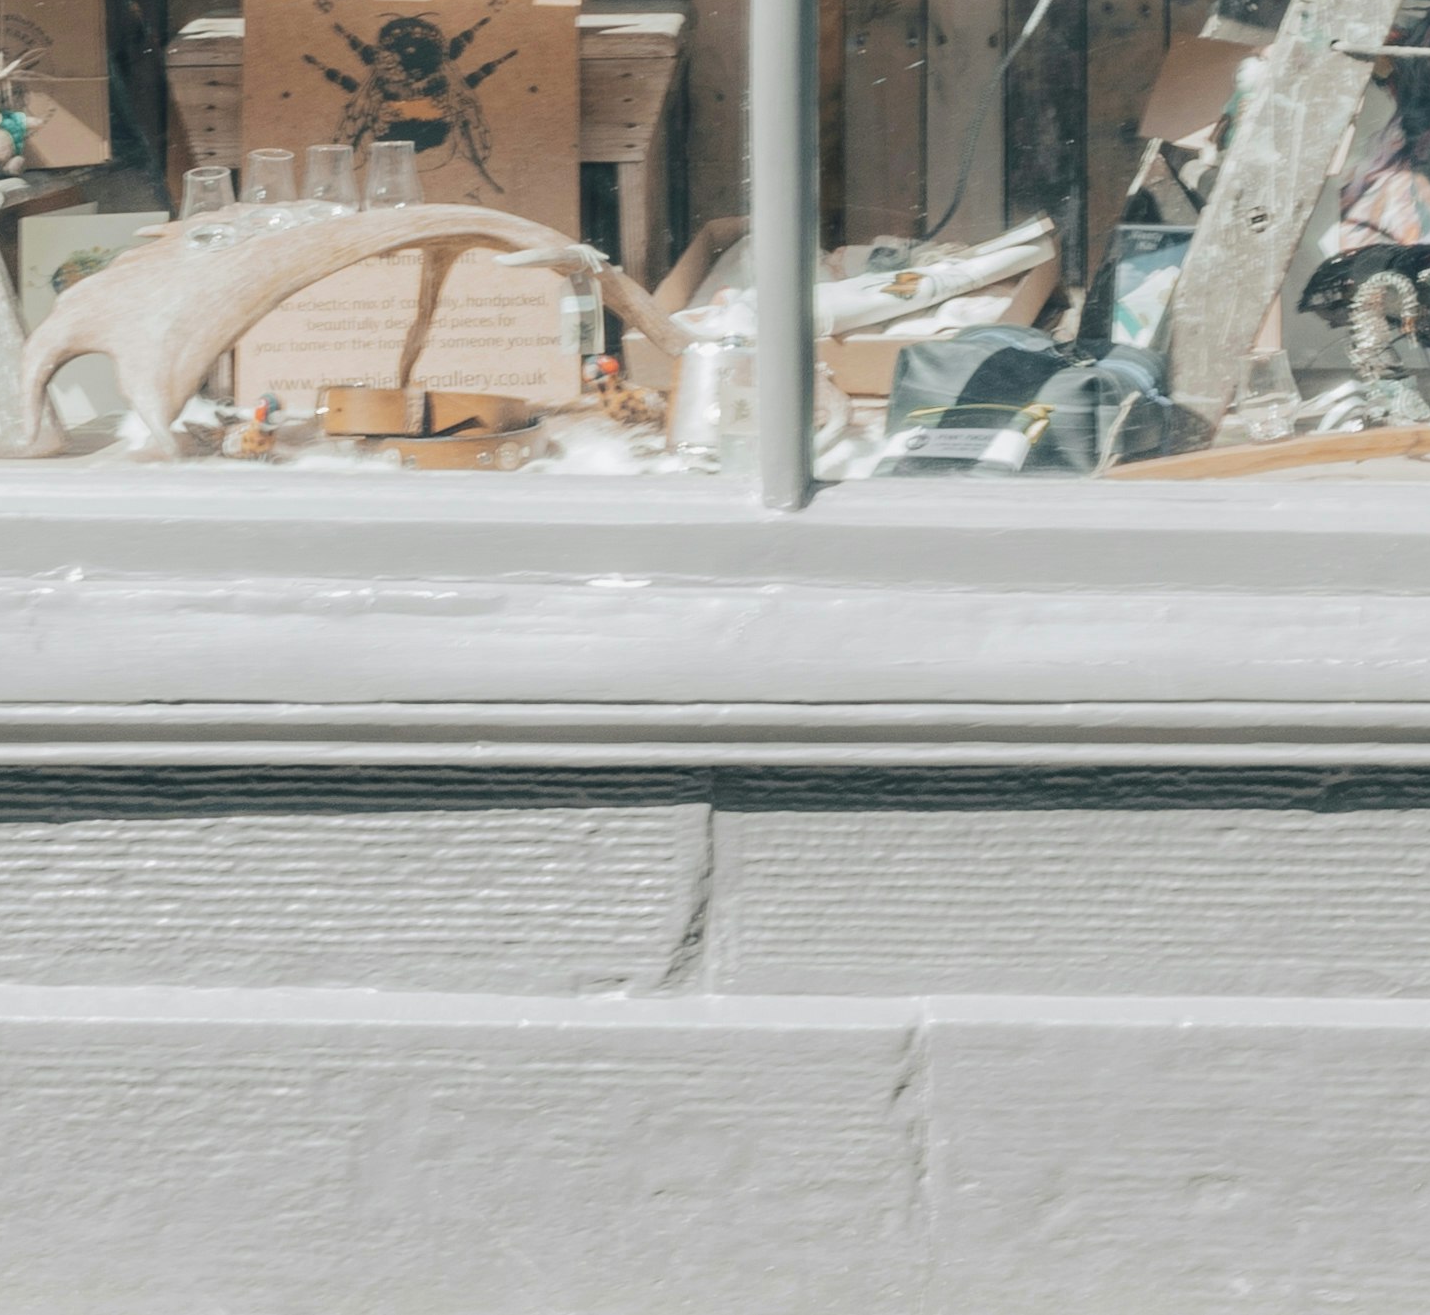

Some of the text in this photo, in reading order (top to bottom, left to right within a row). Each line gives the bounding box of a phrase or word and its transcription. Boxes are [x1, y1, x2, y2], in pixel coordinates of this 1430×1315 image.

[352, 298, 377, 310] mix
[381, 295, 397, 311] of
[385, 316, 448, 330] desed
[450, 316, 495, 331] pieces
[497, 313, 517, 328] for
[255, 342, 283, 356] your
[289, 338, 330, 353] home
[351, 337, 376, 350] the
[439, 334, 504, 350] someone
[507, 336, 532, 352] you
